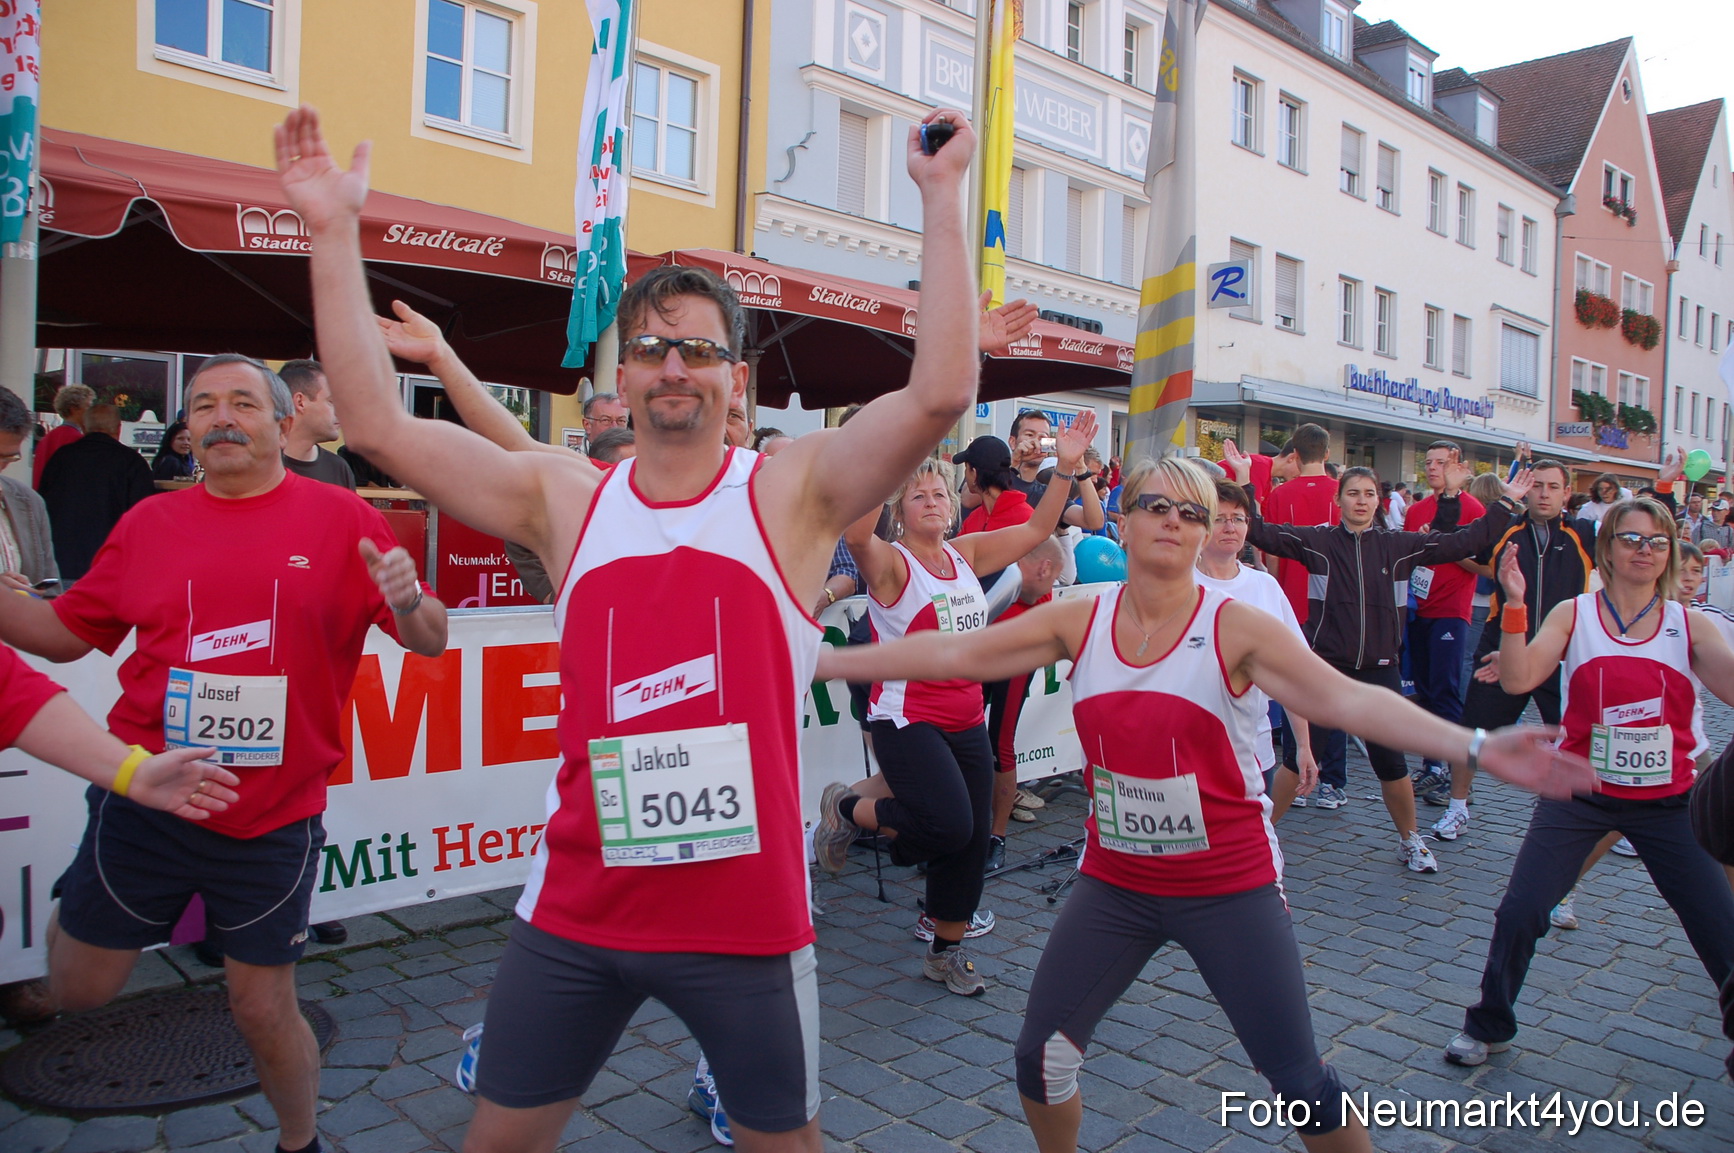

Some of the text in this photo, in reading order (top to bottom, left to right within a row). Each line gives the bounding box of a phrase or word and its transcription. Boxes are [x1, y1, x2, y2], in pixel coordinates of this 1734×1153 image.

[1023, 88, 1092, 141] WEBER
[382, 224, 507, 257] Stadtcafé
[808, 286, 881, 315] Stadtcafé
[1012, 347, 1043, 357] Stadtcafé
[1058, 337, 1105, 356] Stadtcafé
[1344, 364, 1494, 419] Buchhandlung Rupprecht
[950, 593, 975, 607] Martha
[956, 610, 985, 631] 5061
[212, 633, 249, 650] DEHN
[197, 682, 241, 702] Josef
[640, 674, 687, 703] DEHN
[1618, 707, 1646, 719] DEHN
[197, 715, 275, 741] 2502
[1613, 728, 1660, 744] Irmgard
[631, 744, 690, 772] Jakob
[1614, 750, 1667, 769] 5063
[1117, 780, 1166, 803] Bettina
[641, 785, 741, 828] 5043
[1124, 811, 1196, 835] 5044
[319, 831, 418, 893] Mit
